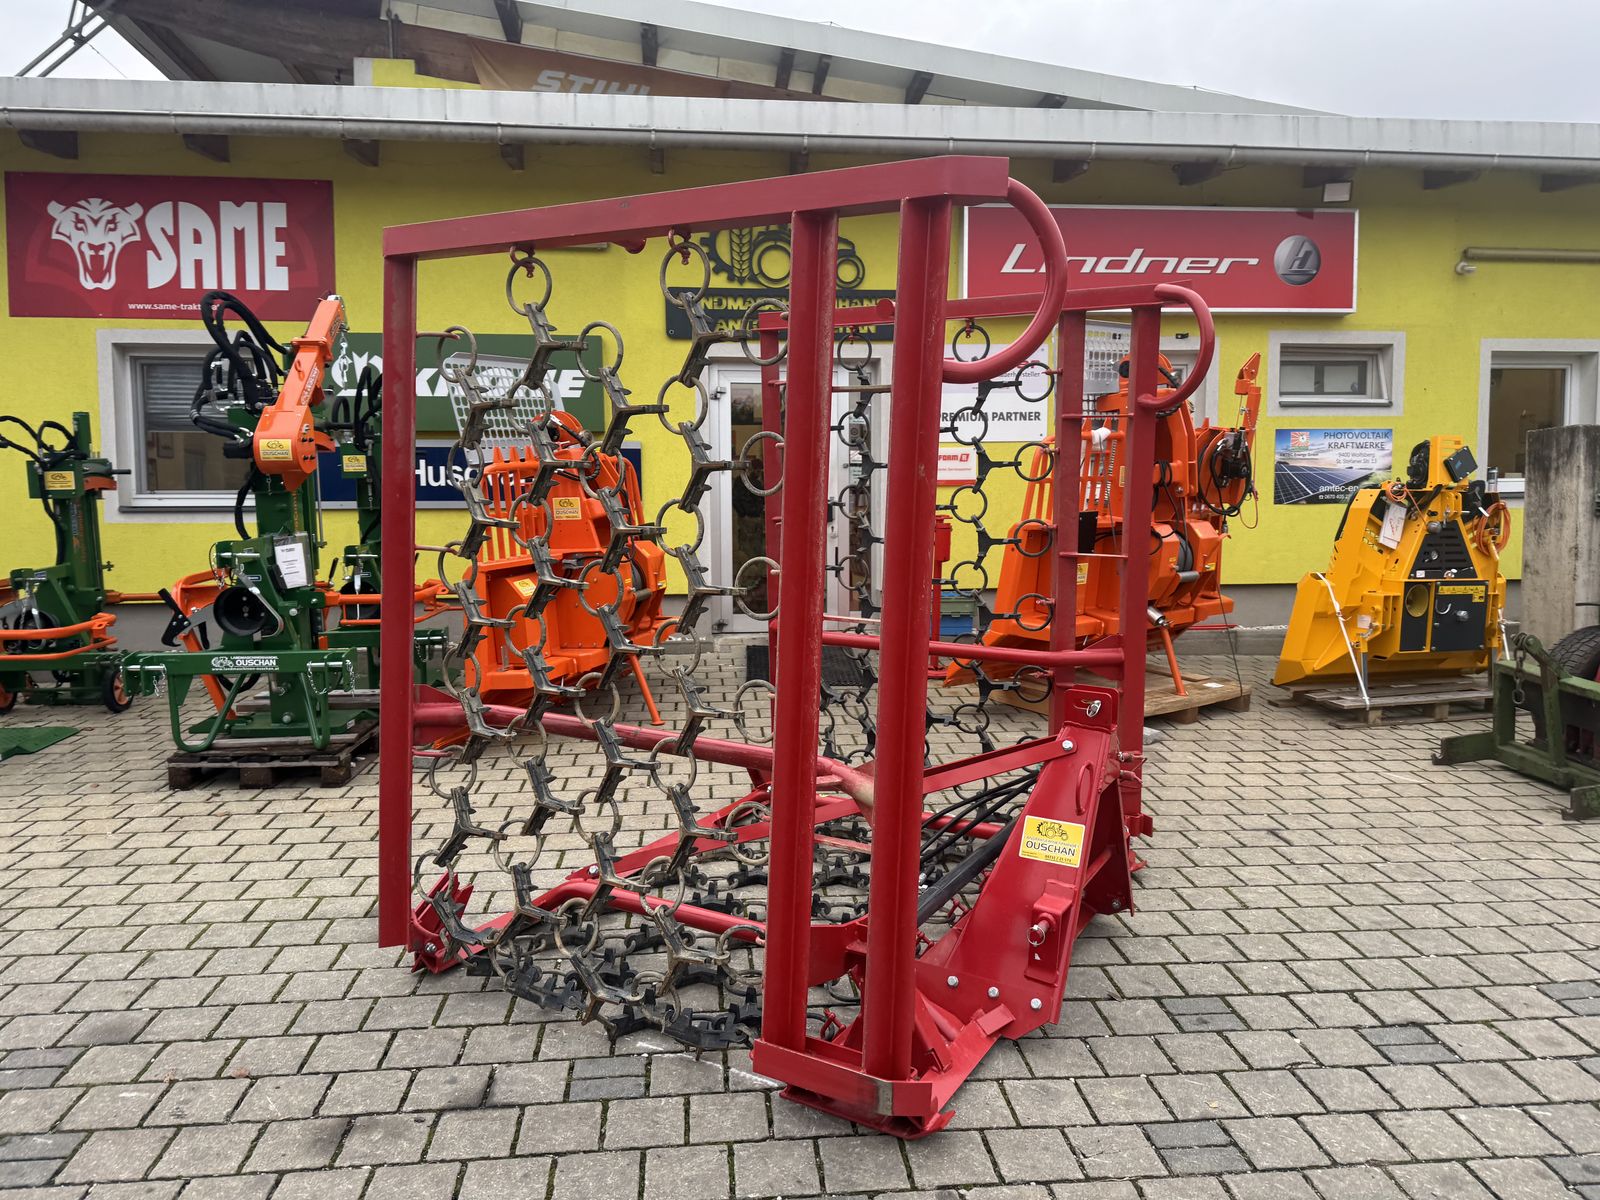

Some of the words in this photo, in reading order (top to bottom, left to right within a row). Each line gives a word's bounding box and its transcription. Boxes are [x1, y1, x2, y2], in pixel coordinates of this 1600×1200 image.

[145, 201, 289, 291] SAME
[1001, 243, 1259, 273] Lndner
[940, 411, 988, 422] REMIUM
[991, 411, 1042, 422] PARTNER
[1324, 432, 1389, 440] PHOTOVOLTAIK
[1026, 840, 1076, 856] OUSCHAN
